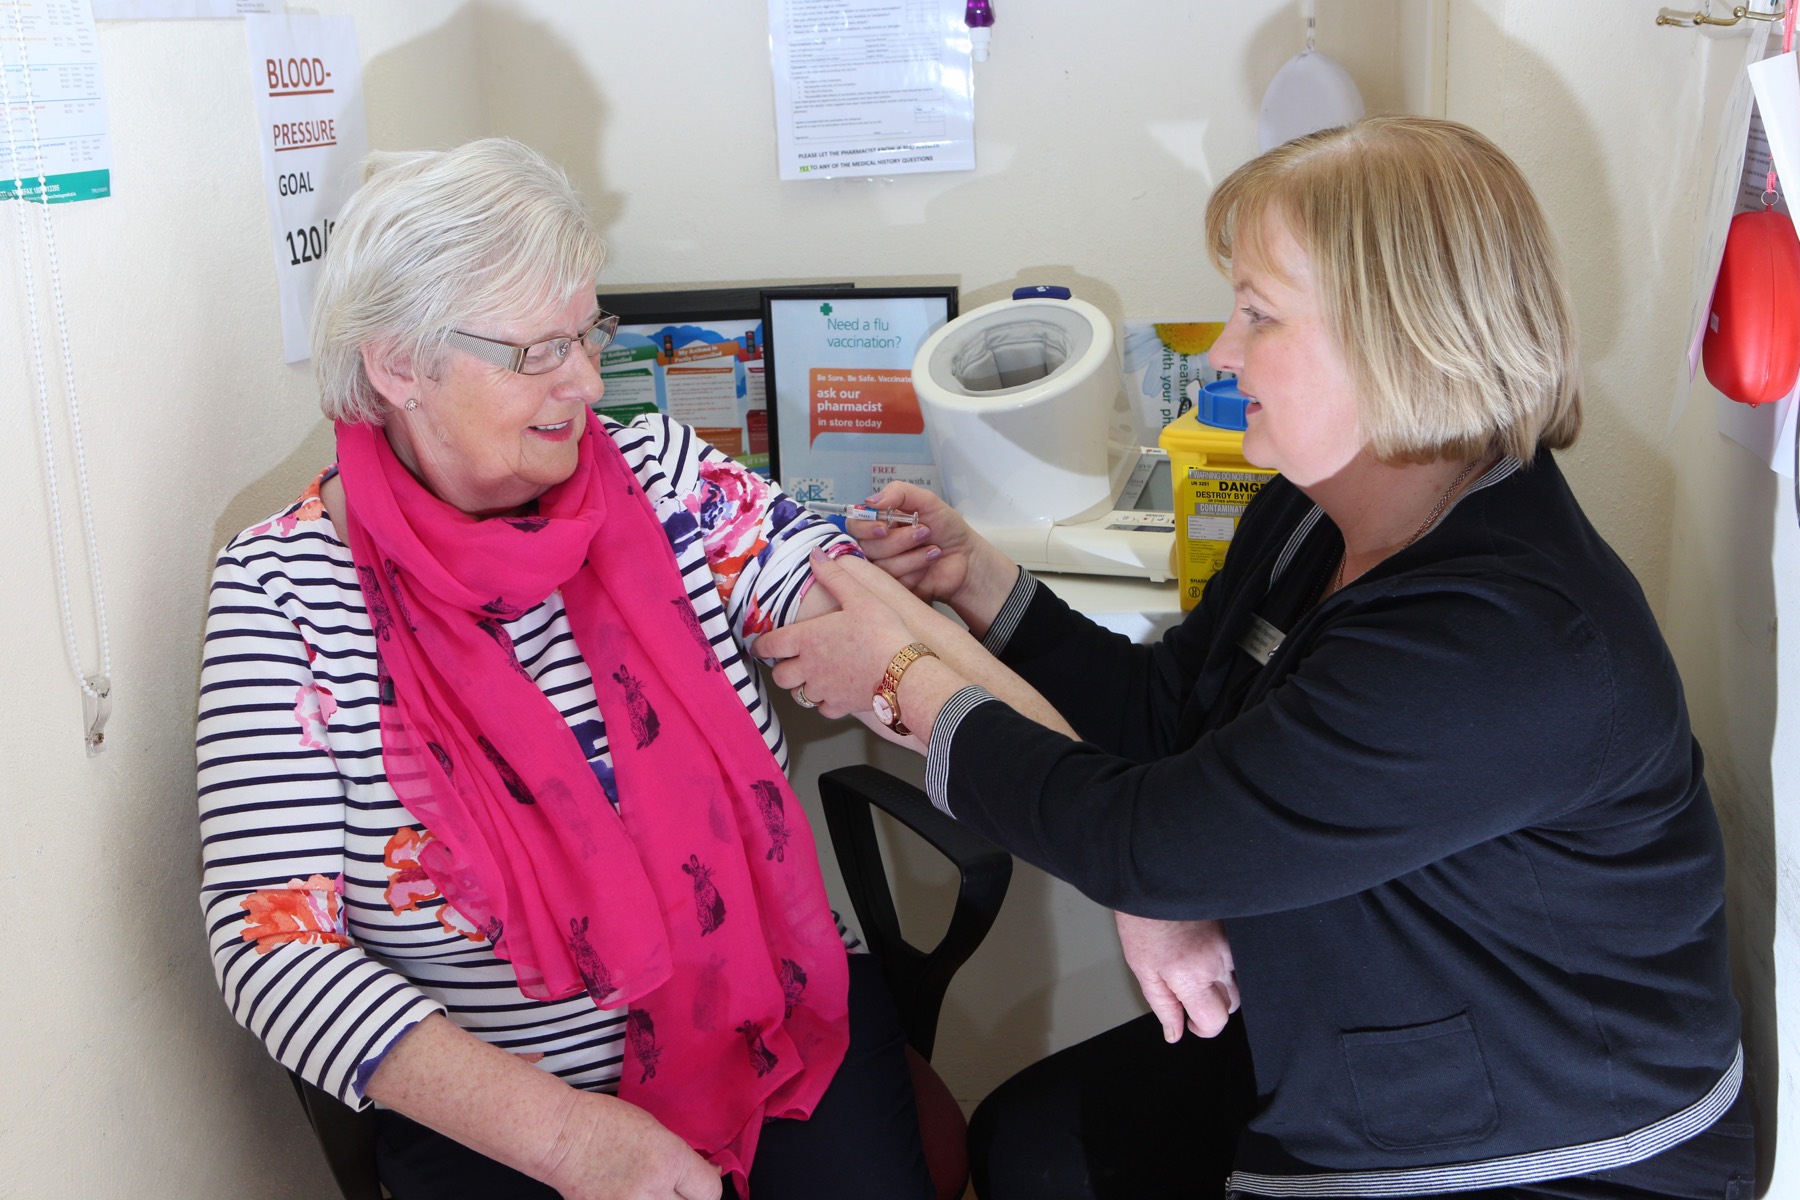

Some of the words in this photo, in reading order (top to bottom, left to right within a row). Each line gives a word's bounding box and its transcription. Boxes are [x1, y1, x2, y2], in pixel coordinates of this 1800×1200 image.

[266, 57, 331, 89] BLOOD-
[273, 119, 336, 147] PRESSURE
[841, 147, 877, 156] PHARMACIST
[852, 160, 877, 168] MEDICAL
[878, 158, 901, 166] HISTORY
[902, 155, 934, 164] QUESTIONS
[278, 171, 314, 197] GOAL
[827, 317, 859, 331] Need
[862, 320, 870, 331] a
[874, 317, 889, 331] flu
[827, 335, 902, 349] vaccination?
[1163, 343, 1175, 370] with
[828, 374, 846, 382] Sure.
[847, 374, 857, 382] Be
[858, 374, 877, 383] Safe.
[817, 387, 837, 398] ask
[839, 390, 860, 399] our
[1160, 375, 1171, 404] your
[817, 400, 882, 413] pharmacist
[818, 417, 827, 426] in
[829, 418, 854, 427] store
[855, 418, 882, 429] today
[872, 466, 897, 474] FREE
[1193, 470, 1220, 480] WARNING
[1221, 472, 1231, 480] DO
[1232, 472, 1245, 481] NOT
[1246, 473, 1256, 482] FILL
[872, 476, 885, 487] For
[908, 477, 925, 488] with
[1219, 481, 1264, 493] DANG
[1196, 491, 1232, 500] DESTROY
